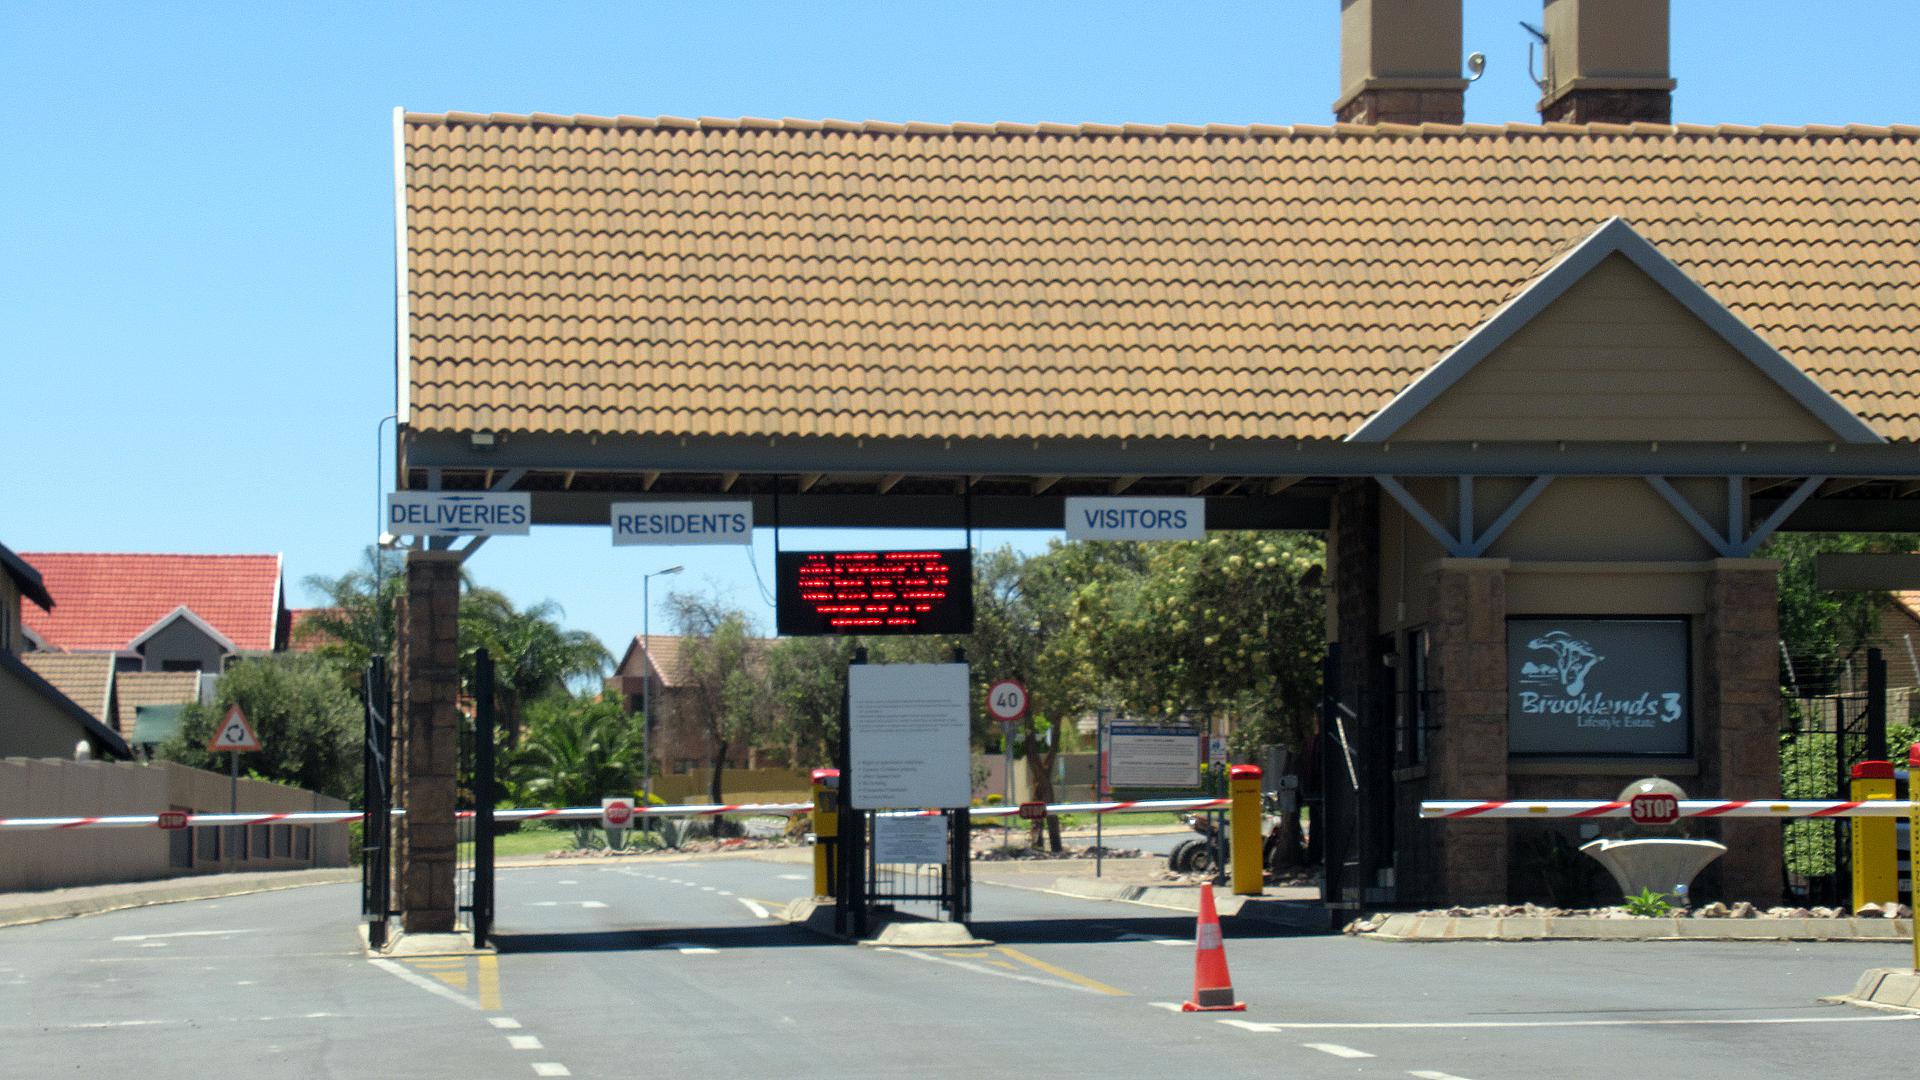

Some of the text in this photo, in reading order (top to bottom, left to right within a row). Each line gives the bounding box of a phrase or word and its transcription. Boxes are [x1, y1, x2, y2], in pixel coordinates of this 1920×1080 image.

[391, 504, 526, 525] DELIVERIES
[617, 513, 746, 535] RESIDENTS
[1084, 509, 1187, 529] VISITORS
[996, 692, 1019, 708] 40
[1519, 691, 1682, 723] Brooklands 3
[1577, 716, 1656, 730] Lifestyle Estate
[1634, 799, 1675, 818] STOP
[160, 815, 185, 826] STOP
